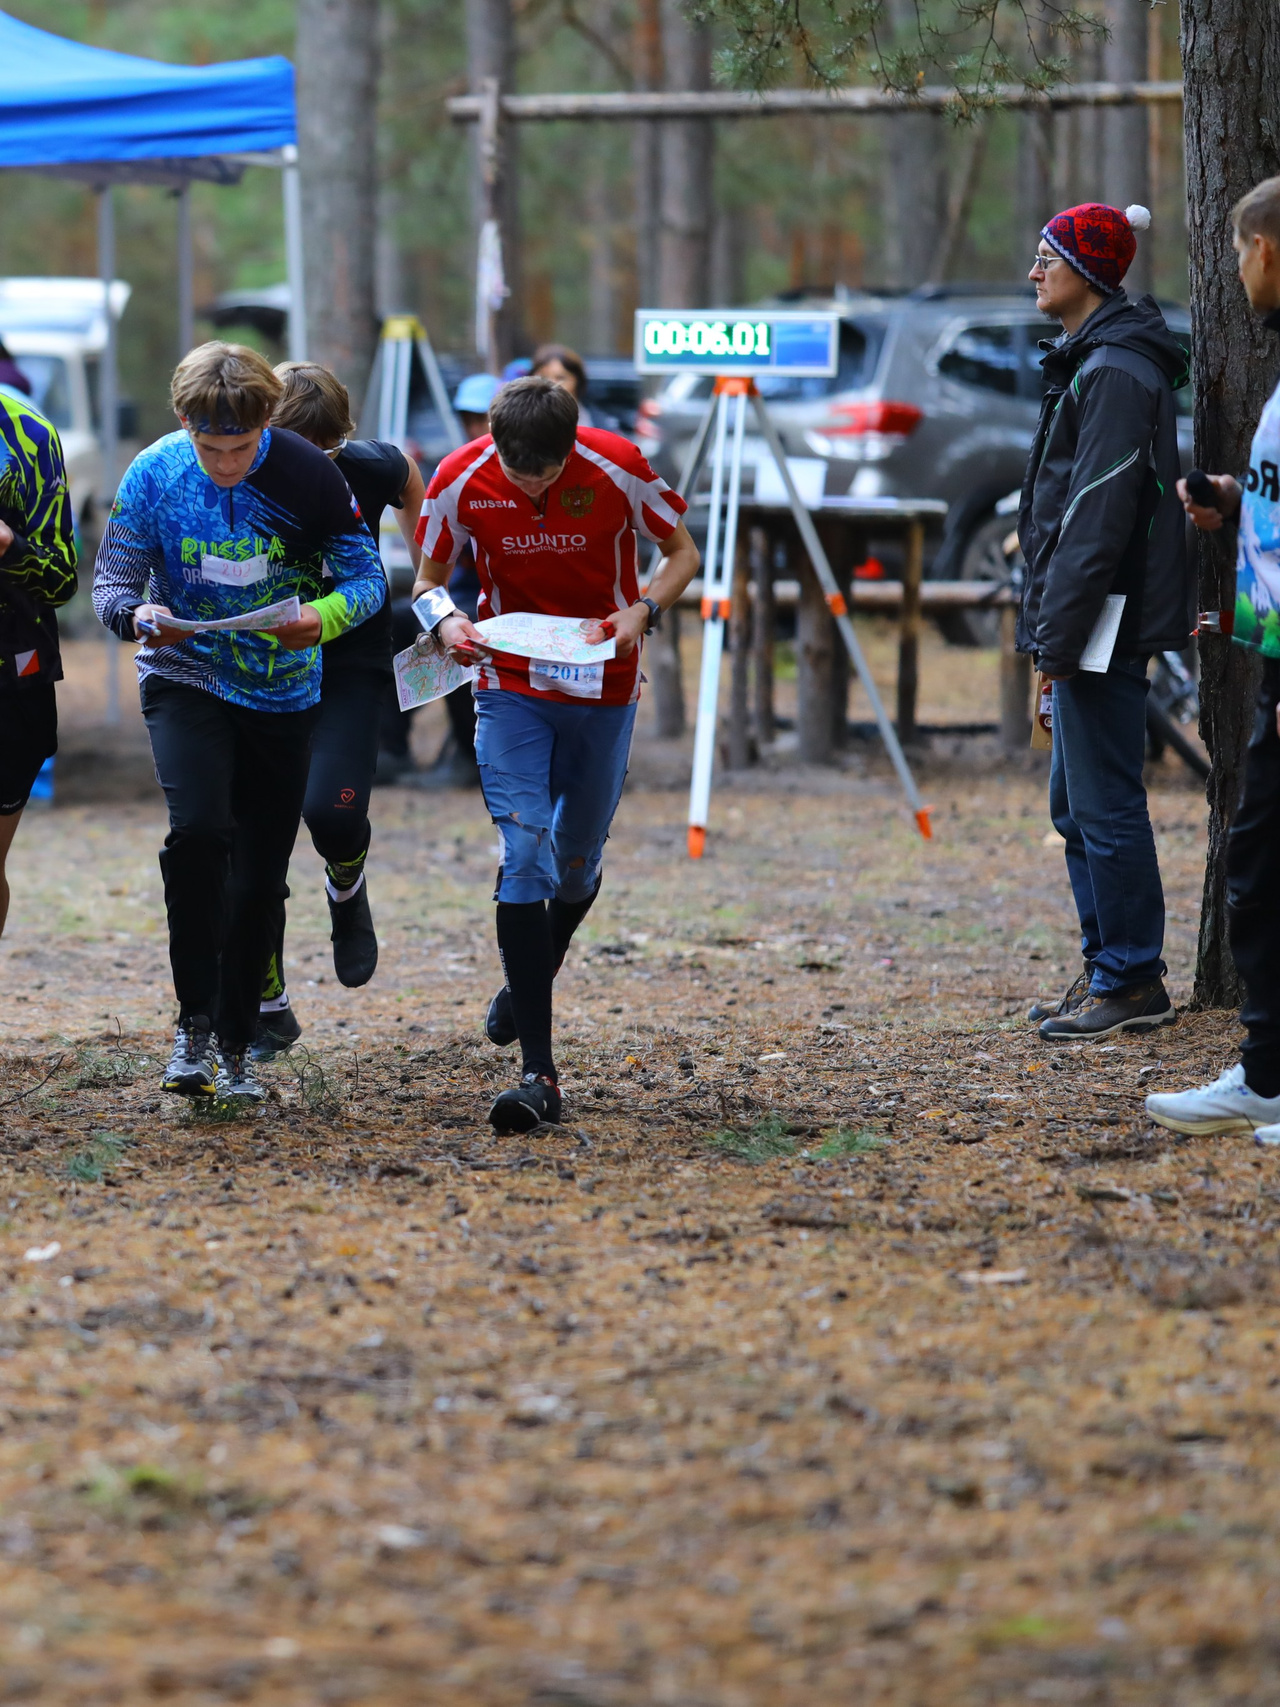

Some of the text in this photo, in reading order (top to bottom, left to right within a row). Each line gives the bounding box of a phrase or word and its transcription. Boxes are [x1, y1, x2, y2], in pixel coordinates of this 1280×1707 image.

[644, 320, 770, 356] 00:06.01
[469, 499, 518, 510] RUSSIA
[181, 535, 286, 566] RUSSIA
[501, 532, 587, 551] SUUNTO
[221, 562, 252, 578] 202
[550, 664, 580, 681] 201
